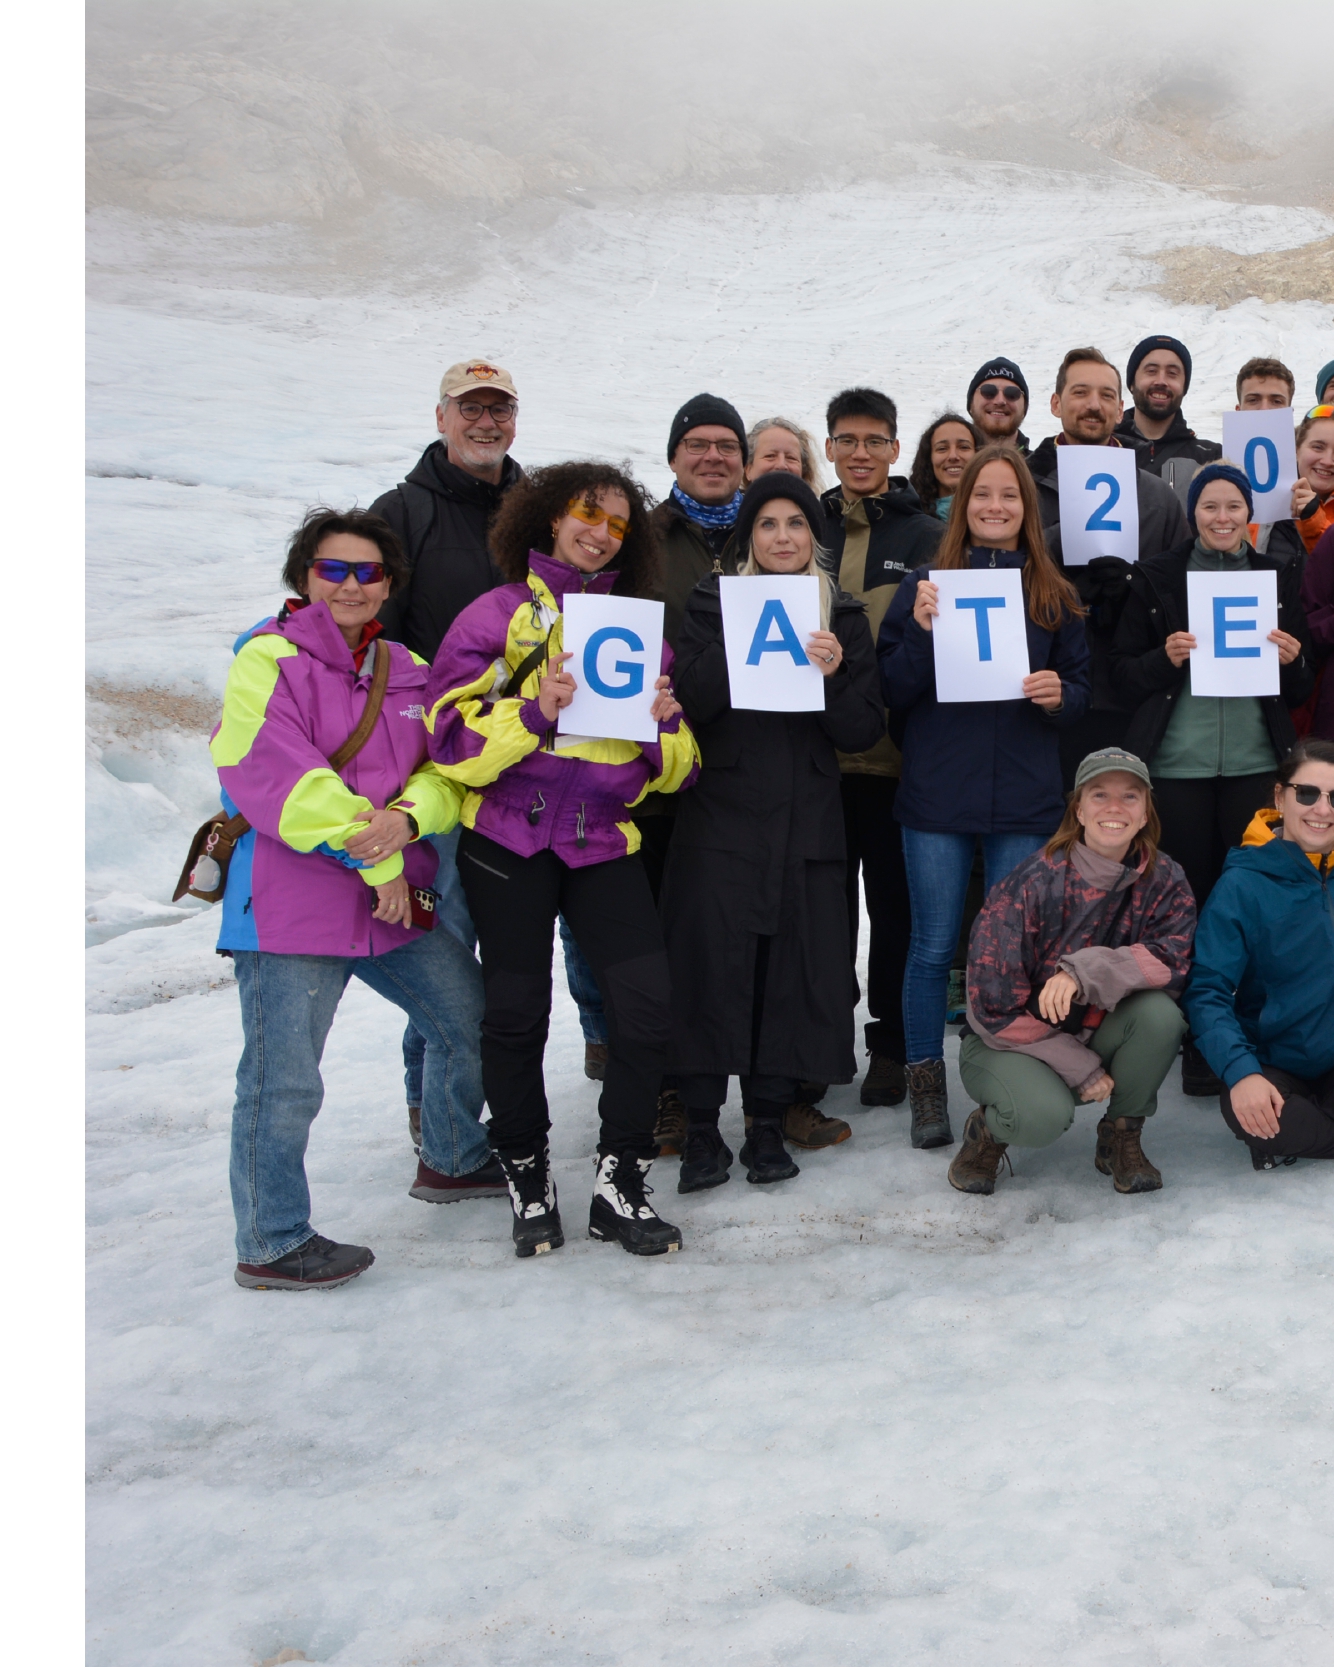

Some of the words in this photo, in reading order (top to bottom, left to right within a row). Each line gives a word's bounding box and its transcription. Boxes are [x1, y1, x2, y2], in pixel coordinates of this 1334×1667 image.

[1243, 437, 1280, 493] 0
[1085, 472, 1122, 532] 2
[745, 599, 810, 666] A
[955, 597, 1006, 662] T
[1212, 596, 1261, 659] E
[583, 626, 645, 699] G
